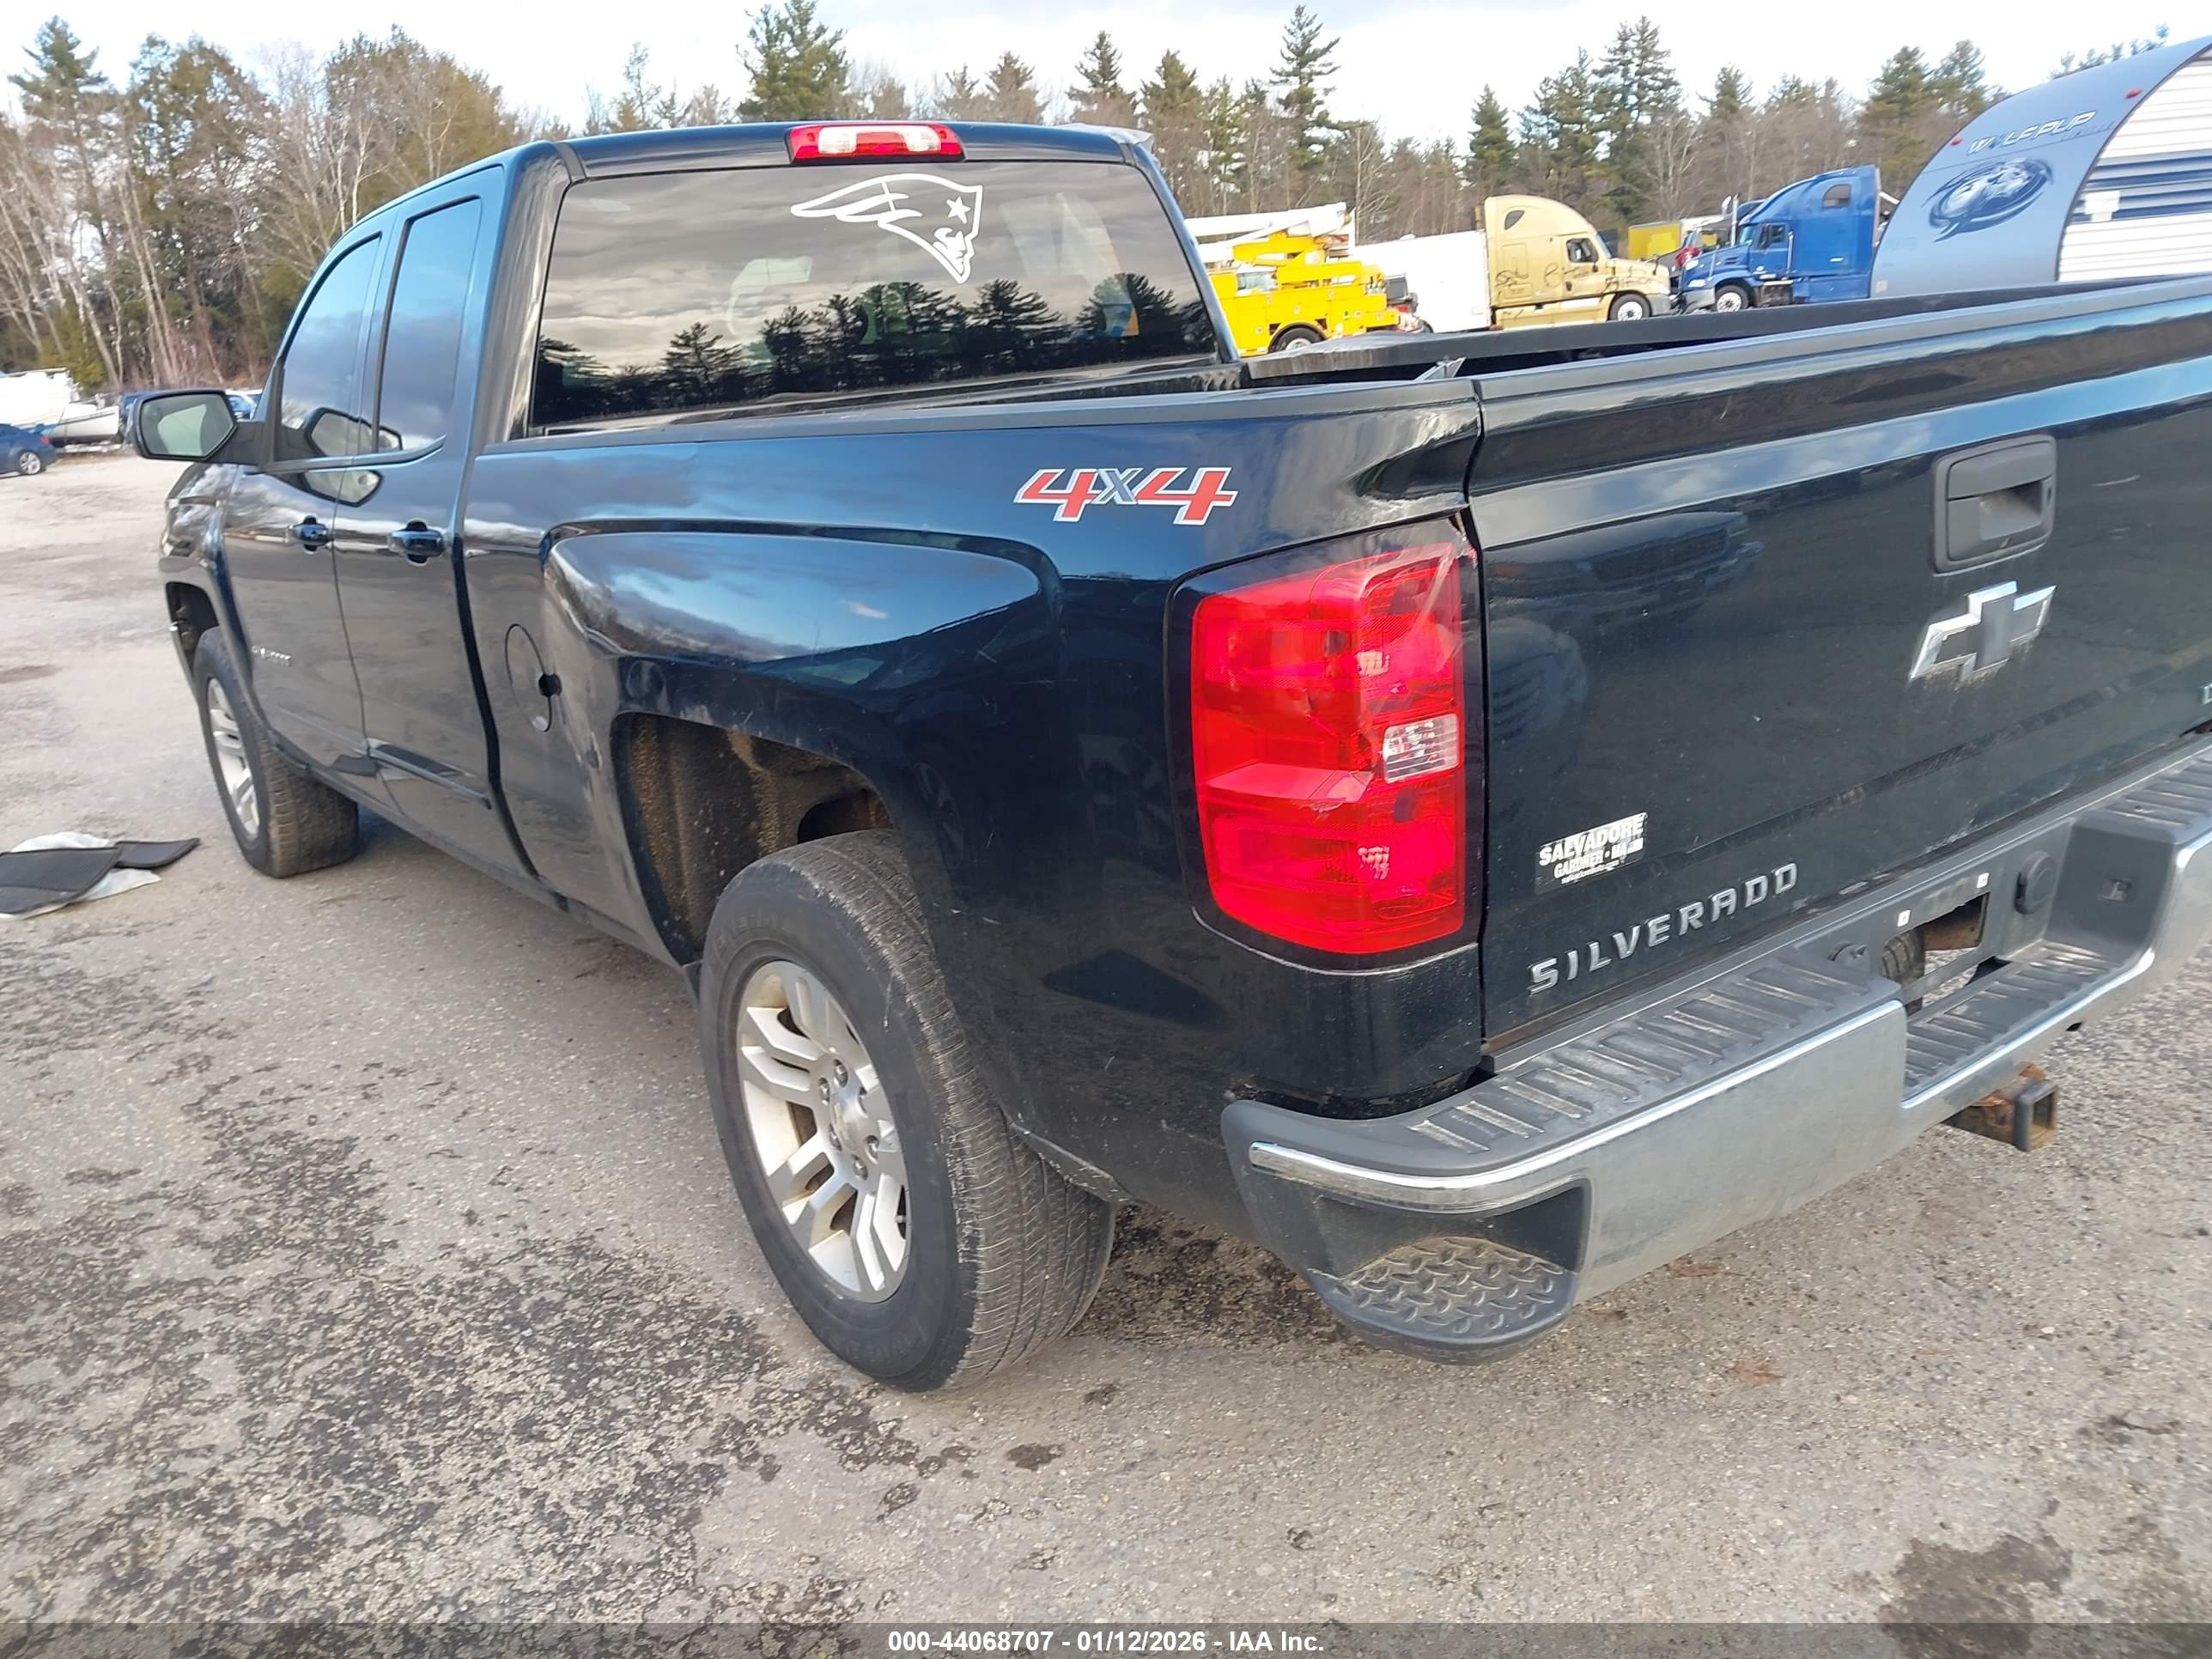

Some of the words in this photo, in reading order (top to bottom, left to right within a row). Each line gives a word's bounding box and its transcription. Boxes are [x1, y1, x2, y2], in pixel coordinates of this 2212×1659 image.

[2030, 109, 2097, 141] PUP
[1539, 817, 1644, 866] SALVADORE
[1528, 861, 1799, 995] SILVERADO
